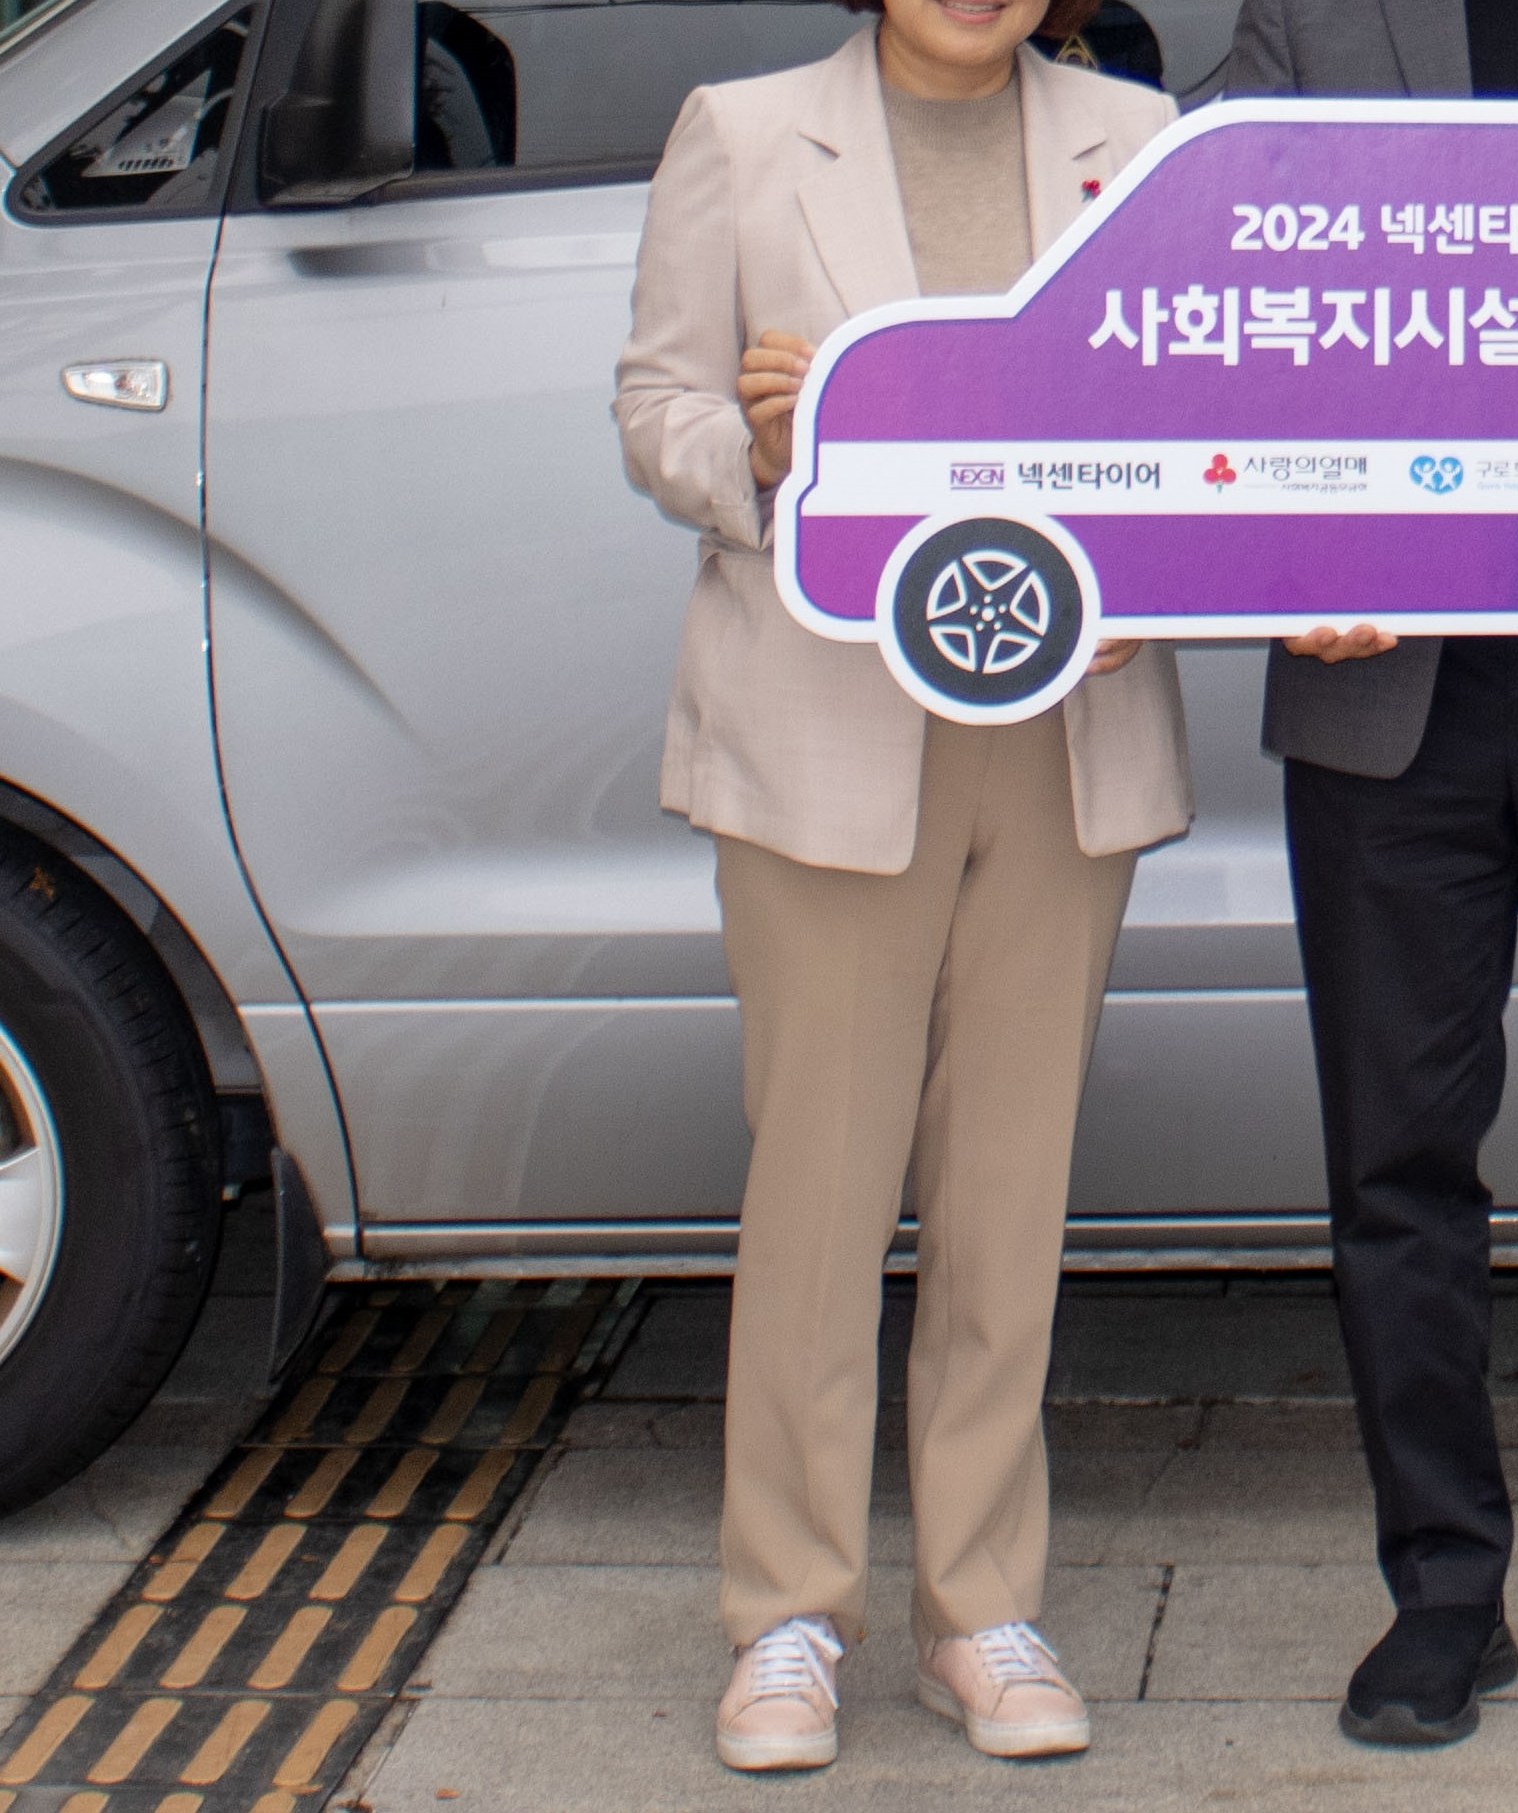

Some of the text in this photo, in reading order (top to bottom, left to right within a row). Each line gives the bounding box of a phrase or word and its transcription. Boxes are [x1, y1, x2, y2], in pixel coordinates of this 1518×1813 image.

[1230, 206, 1365, 253] 2024
[1018, 462, 1161, 490] 넥센타이어
[1244, 456, 1368, 481] 사랑의열매
